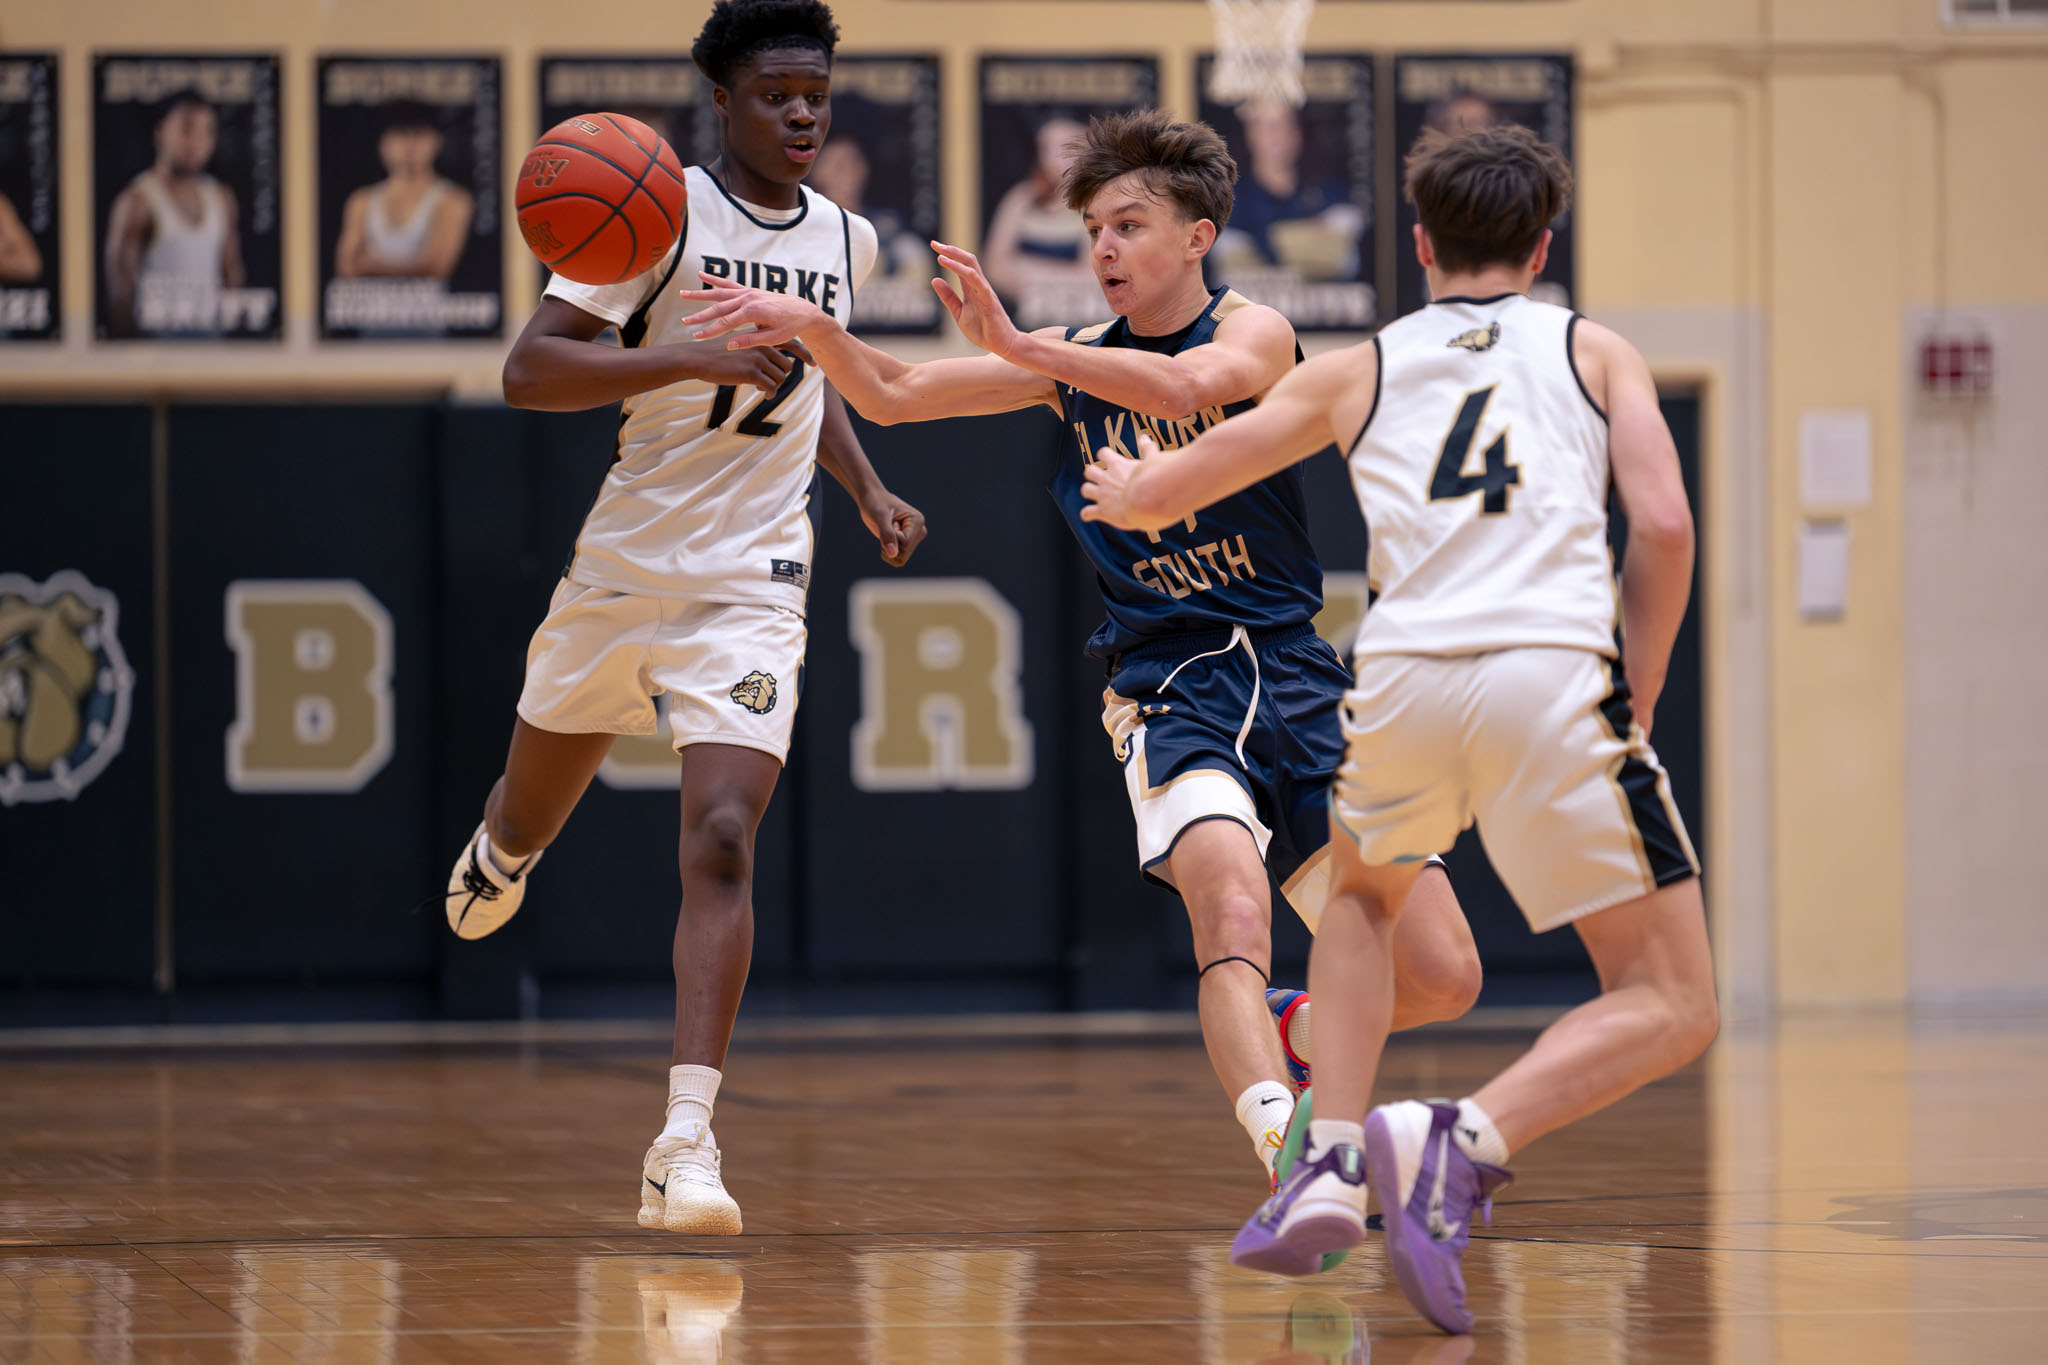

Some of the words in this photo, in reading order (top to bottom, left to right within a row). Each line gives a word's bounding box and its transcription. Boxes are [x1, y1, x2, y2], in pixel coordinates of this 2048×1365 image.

[701, 255, 841, 317] BURKE
[1426, 381, 1523, 518] 4
[1132, 534, 1256, 600] SOUTH
